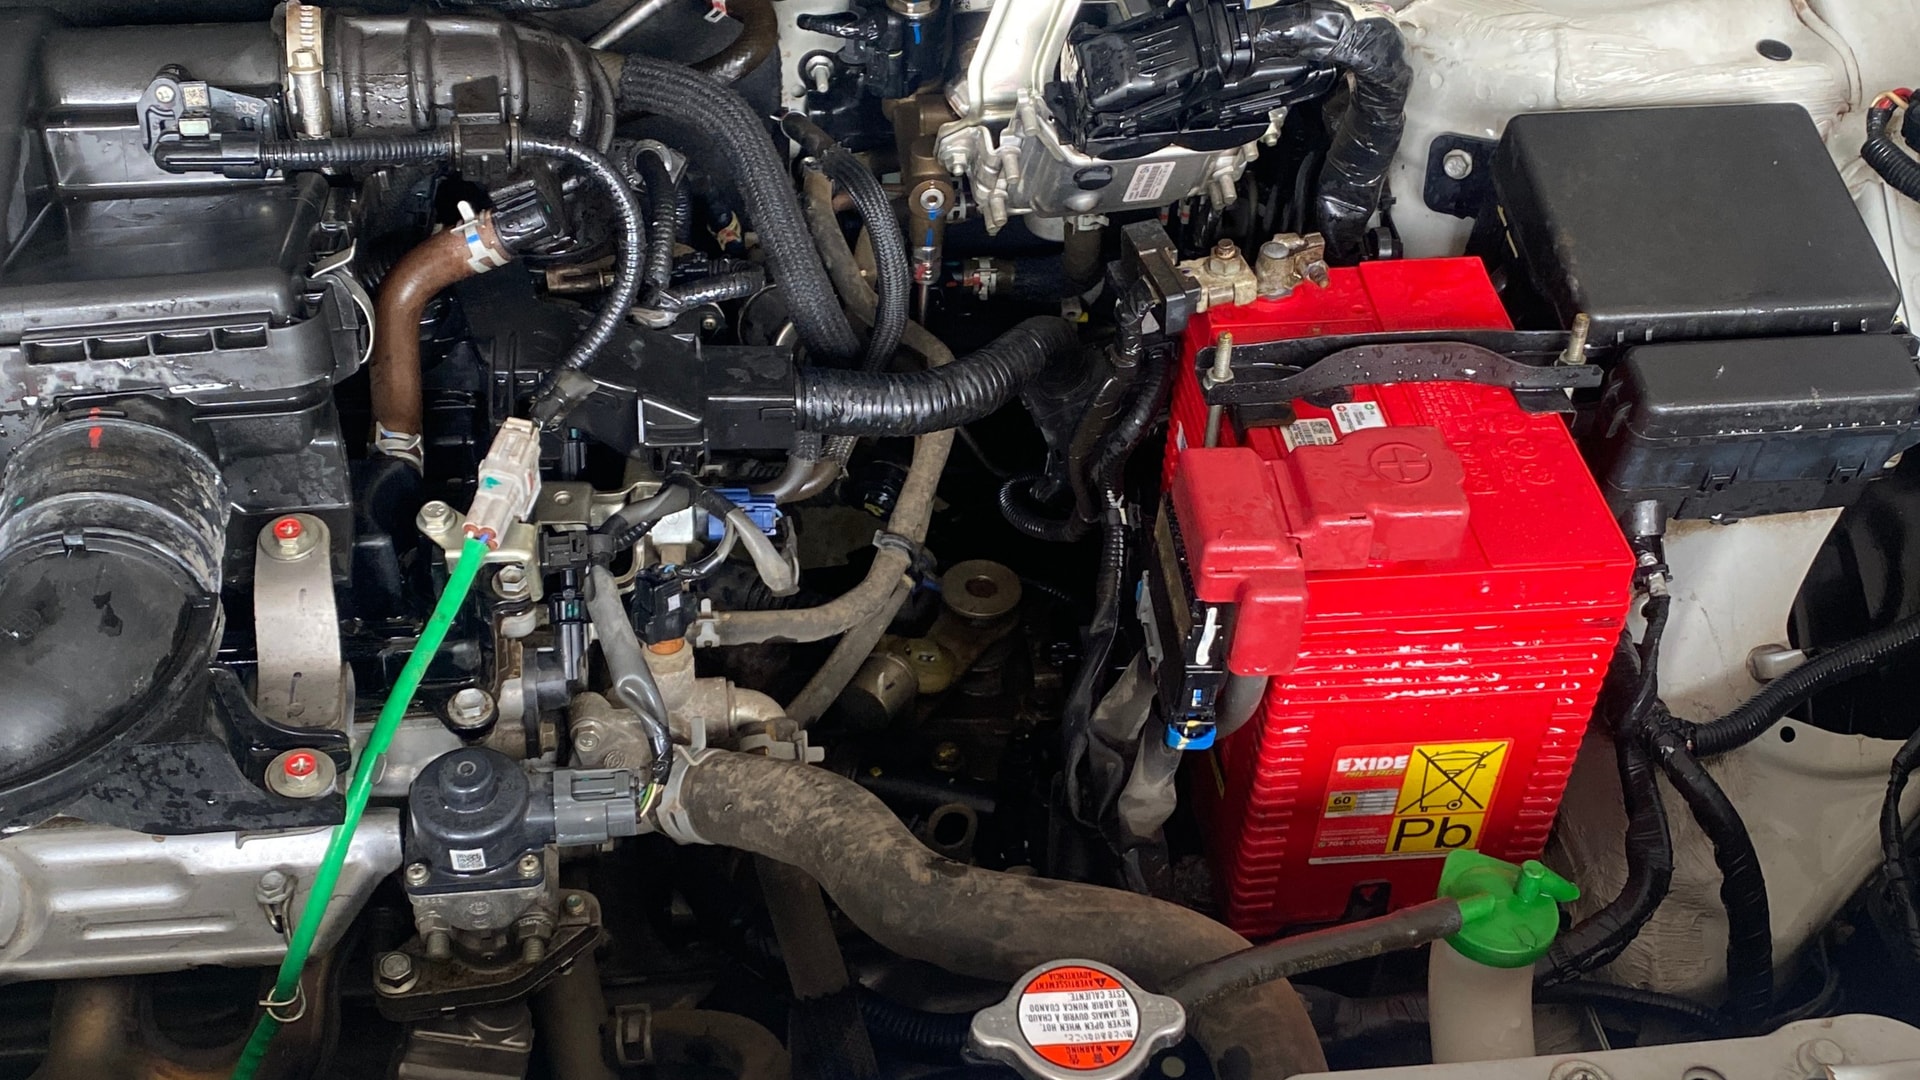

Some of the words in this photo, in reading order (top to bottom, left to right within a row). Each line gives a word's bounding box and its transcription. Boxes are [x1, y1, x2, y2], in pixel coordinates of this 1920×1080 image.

[1336, 755, 1410, 772] EXIDE
[1333, 796, 1351, 805] 60
[1392, 817, 1473, 851] Pb
[1035, 980, 1094, 990] AVERTISSEMENT
[1108, 990, 1126, 998] ESTE
[1062, 1002, 1089, 1010] NUNCA
[1091, 1000, 1113, 1009] ABRIR
[1117, 999, 1128, 1007] NO
[1029, 1004, 1059, 1012] CUANDO
[1119, 1008, 1129, 1017] NE
[1062, 1012, 1089, 1020] OUVRIR
[1091, 1010, 1117, 1019] JAMAIS
[1084, 1021, 1104, 1030] OPEN
[1106, 1019, 1131, 1028] NEVER
[1065, 1045, 1103, 1054] WARNING
